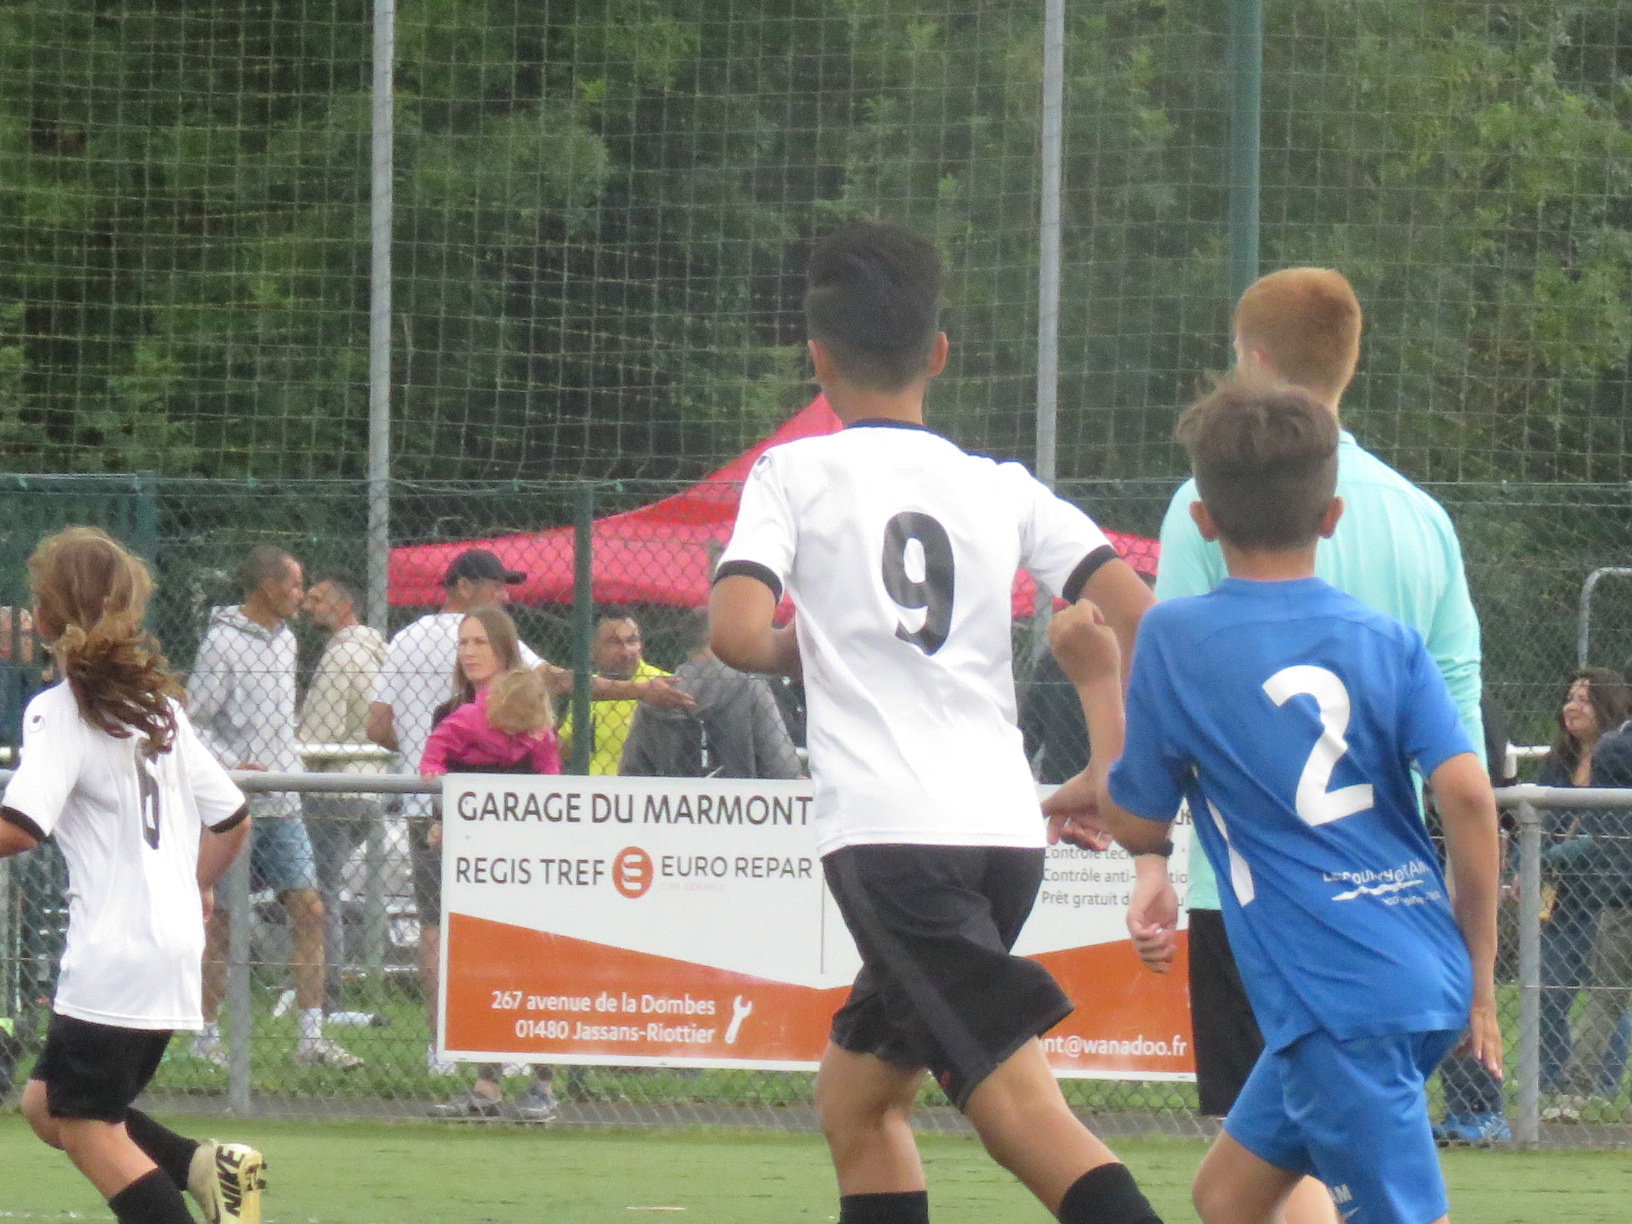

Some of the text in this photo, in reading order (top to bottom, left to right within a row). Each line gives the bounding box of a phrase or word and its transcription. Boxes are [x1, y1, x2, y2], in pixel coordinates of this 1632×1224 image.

[882, 511, 955, 656] 9
[1262, 664, 1373, 826] 2
[457, 791, 813, 826] GARAGE DU MARMONT
[456, 857, 605, 886] REGIS TREF
[661, 856, 812, 879] EURO REPAR
[1072, 891, 1118, 908] gratuit
[491, 989, 716, 1015] 267 avenue de la Dombes
[515, 1019, 715, 1043] 01480 Jassans-Riottier
[1040, 1034, 1188, 1058] nt@wanadoo.fr
[216, 1144, 246, 1217] NIKE
